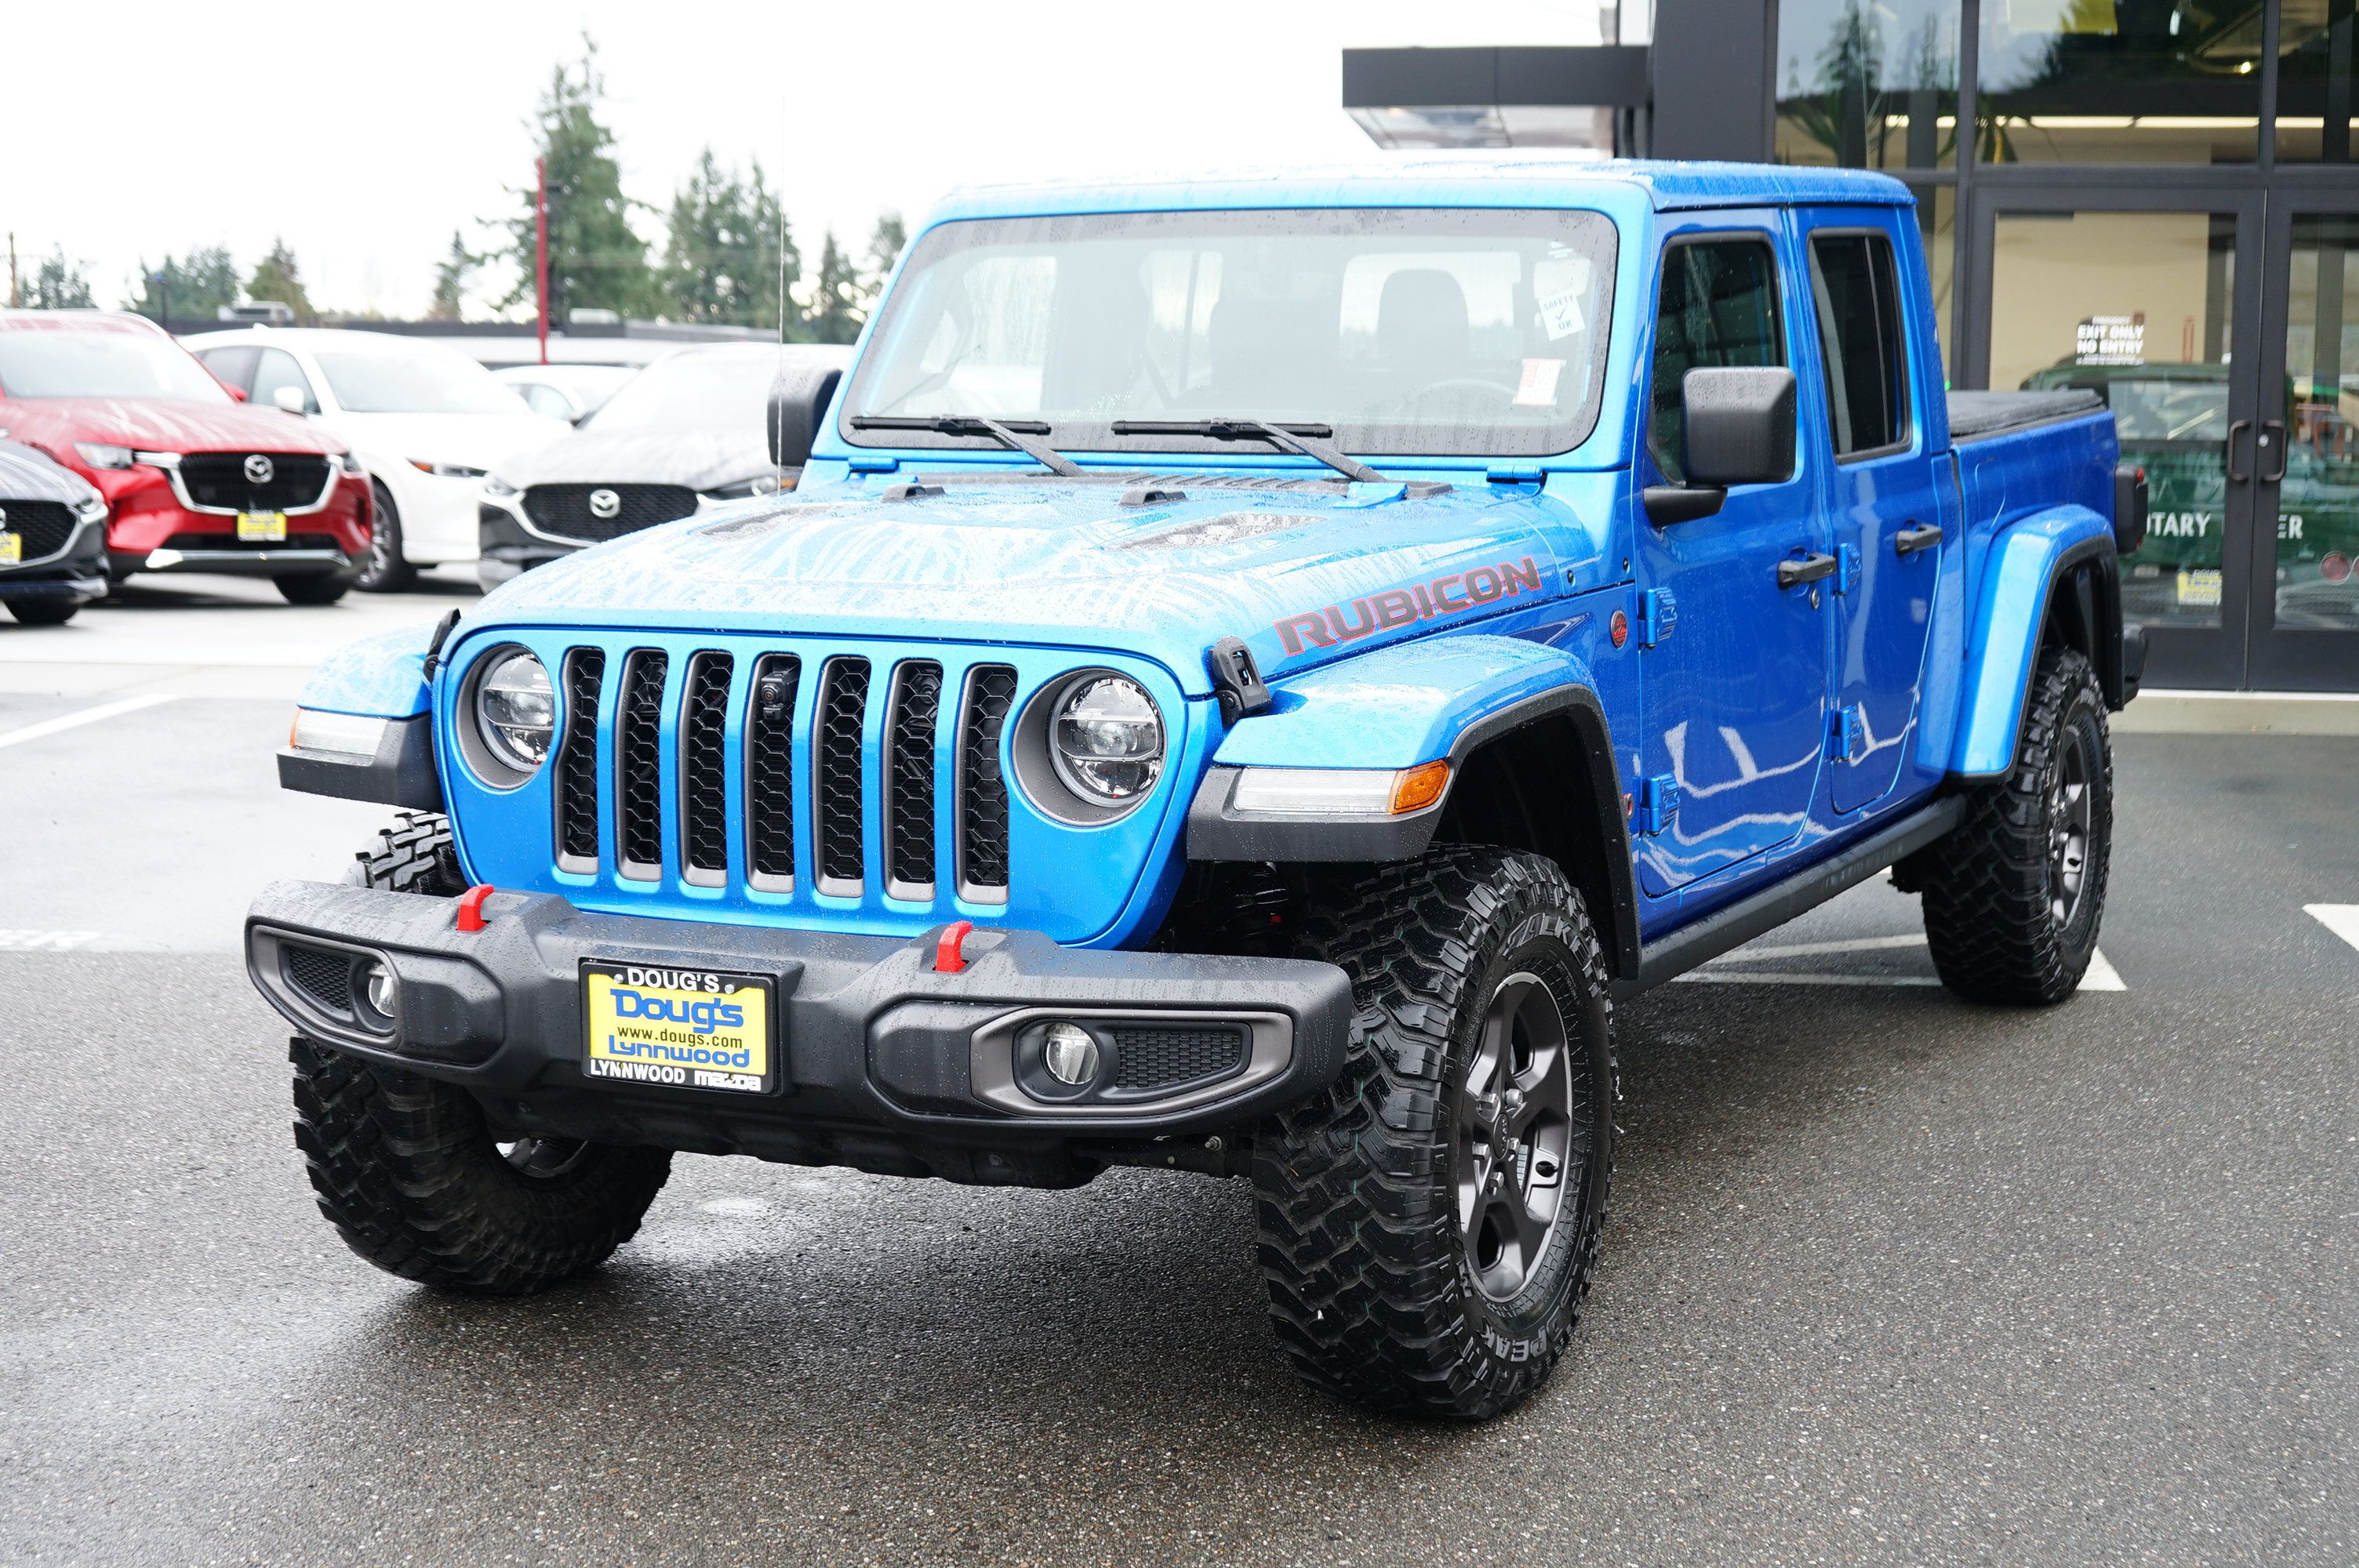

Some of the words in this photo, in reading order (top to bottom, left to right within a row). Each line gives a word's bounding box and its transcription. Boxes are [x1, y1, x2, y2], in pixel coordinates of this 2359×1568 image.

[1543, 294, 1573, 311] SAFETY
[1558, 319, 1573, 330] OK
[2077, 324, 2107, 339] EXIT
[2109, 324, 2145, 339] ONLY
[2077, 339, 2098, 354] NO
[2099, 339, 2143, 354] ENTRY
[2146, 512, 2212, 537] TARY
[1273, 555, 1542, 656] RUBICON
[627, 967, 720, 993] DOUG'S
[617, 1026, 743, 1049] www.dougs.com
[609, 1035, 750, 1069] Lynnwood
[591, 1058, 685, 1084] LYNNWOOD
